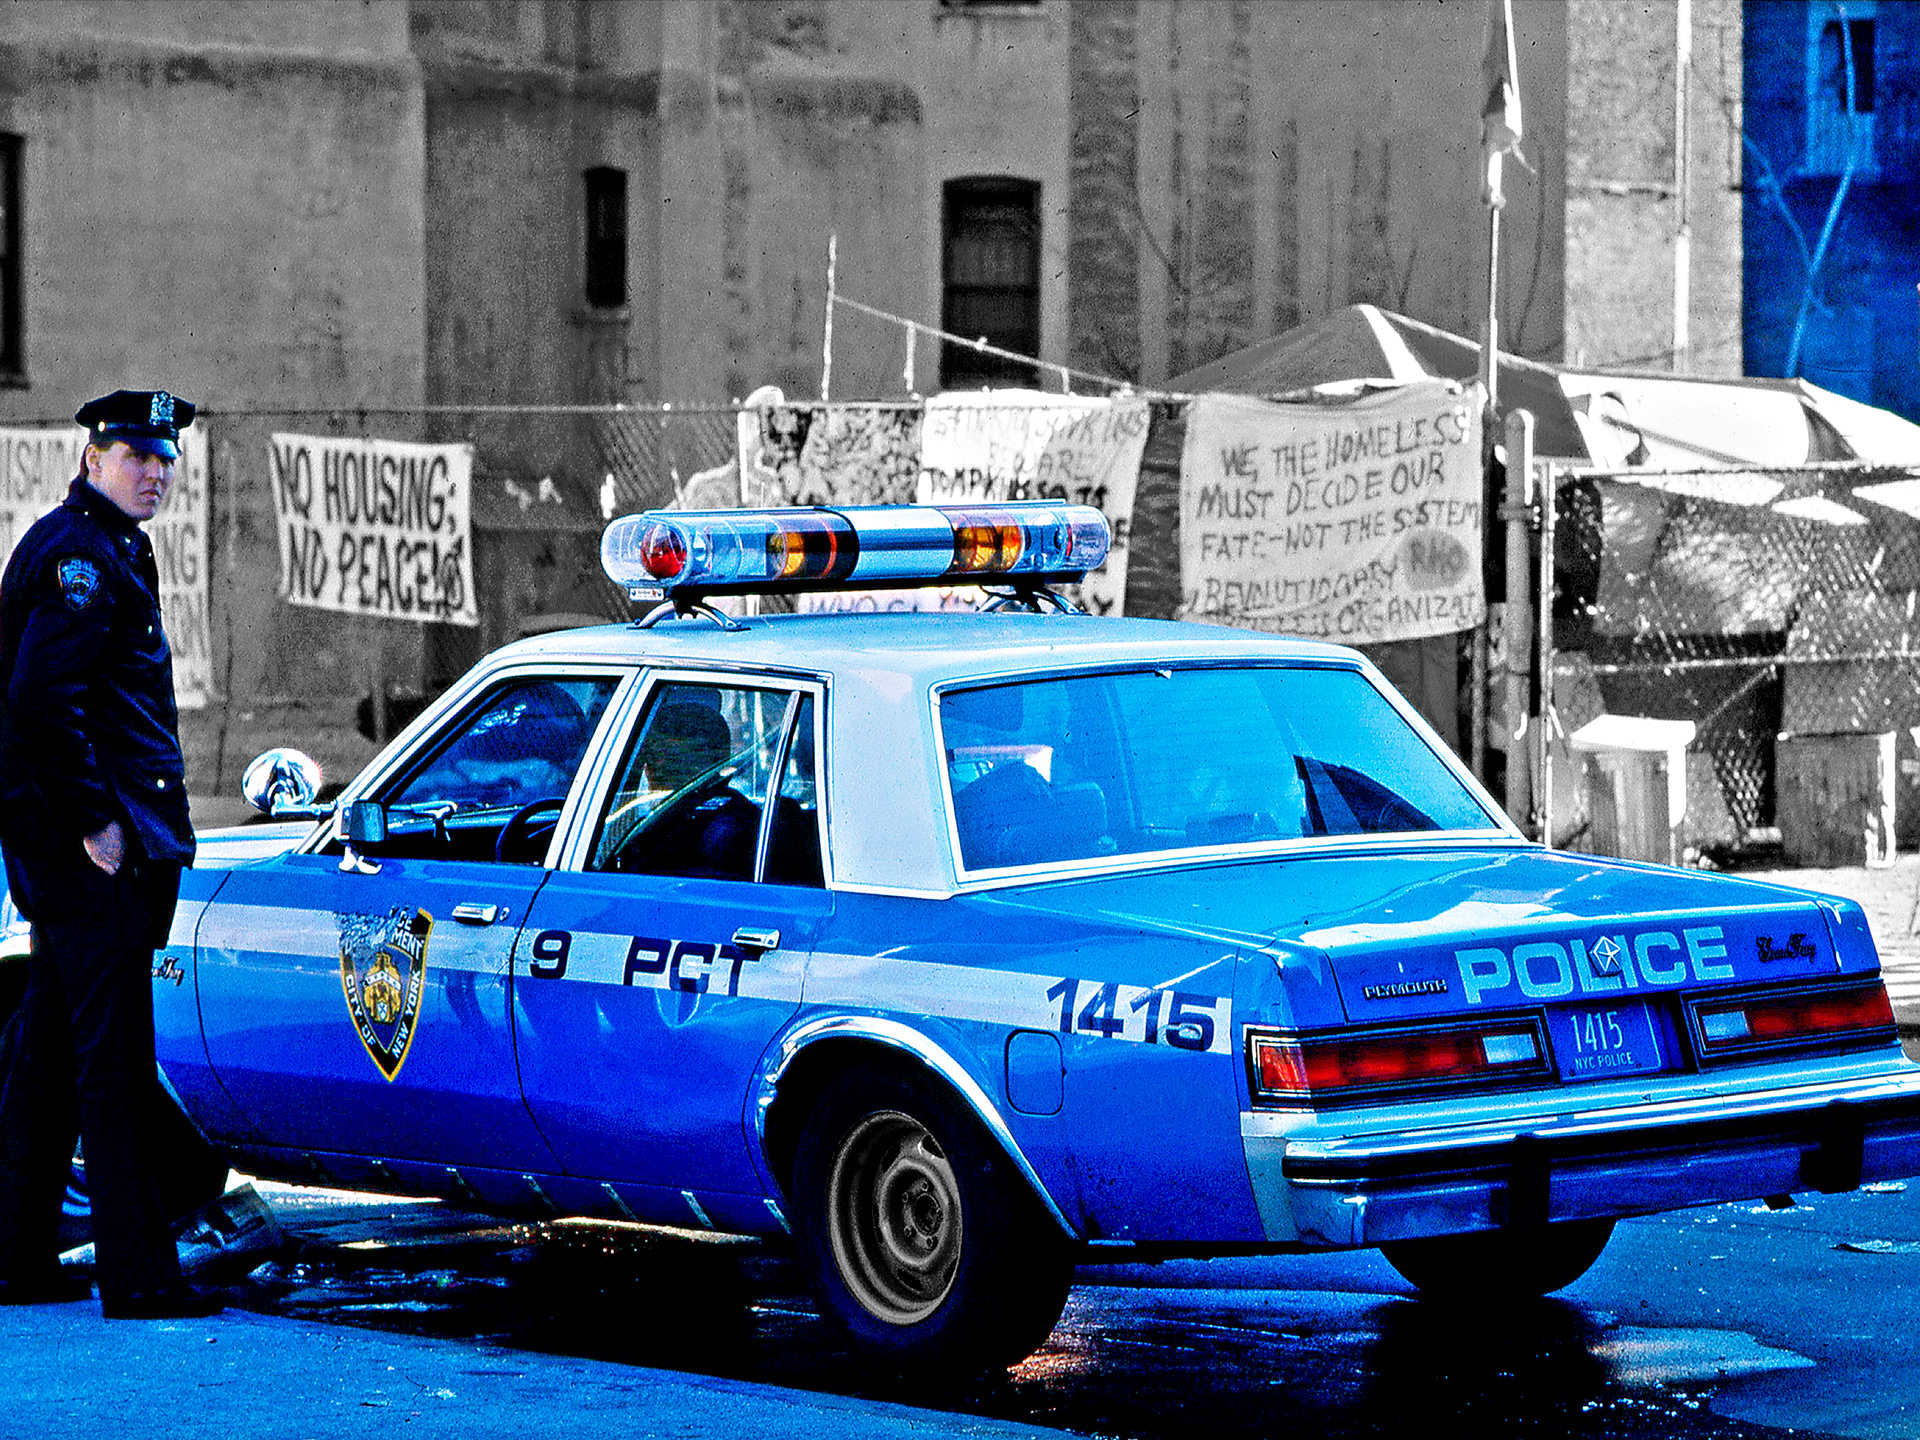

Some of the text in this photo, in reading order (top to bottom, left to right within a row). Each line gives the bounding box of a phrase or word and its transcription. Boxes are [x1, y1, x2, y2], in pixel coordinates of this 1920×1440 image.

[1273, 441, 1317, 477] THE
[1325, 412, 1466, 471] HOMELESS
[273, 444, 311, 520] NO
[1197, 451, 1444, 519] MUST DECIDE OUR
[289, 523, 328, 599] NO
[1338, 511, 1386, 545] THE
[530, 930, 761, 997] 9 PCT
[1362, 979, 1449, 1001] PLYMOUTH
[1455, 925, 1735, 1004] POLICE
[345, 973, 363, 1017] CITY
[361, 1023, 376, 1046] OF
[391, 969, 421, 1059] NEW YORK
[1045, 976, 1215, 1052] 1415
[1571, 1011, 1623, 1053] 1415
[1575, 1051, 1634, 1070] NYC POLICE
